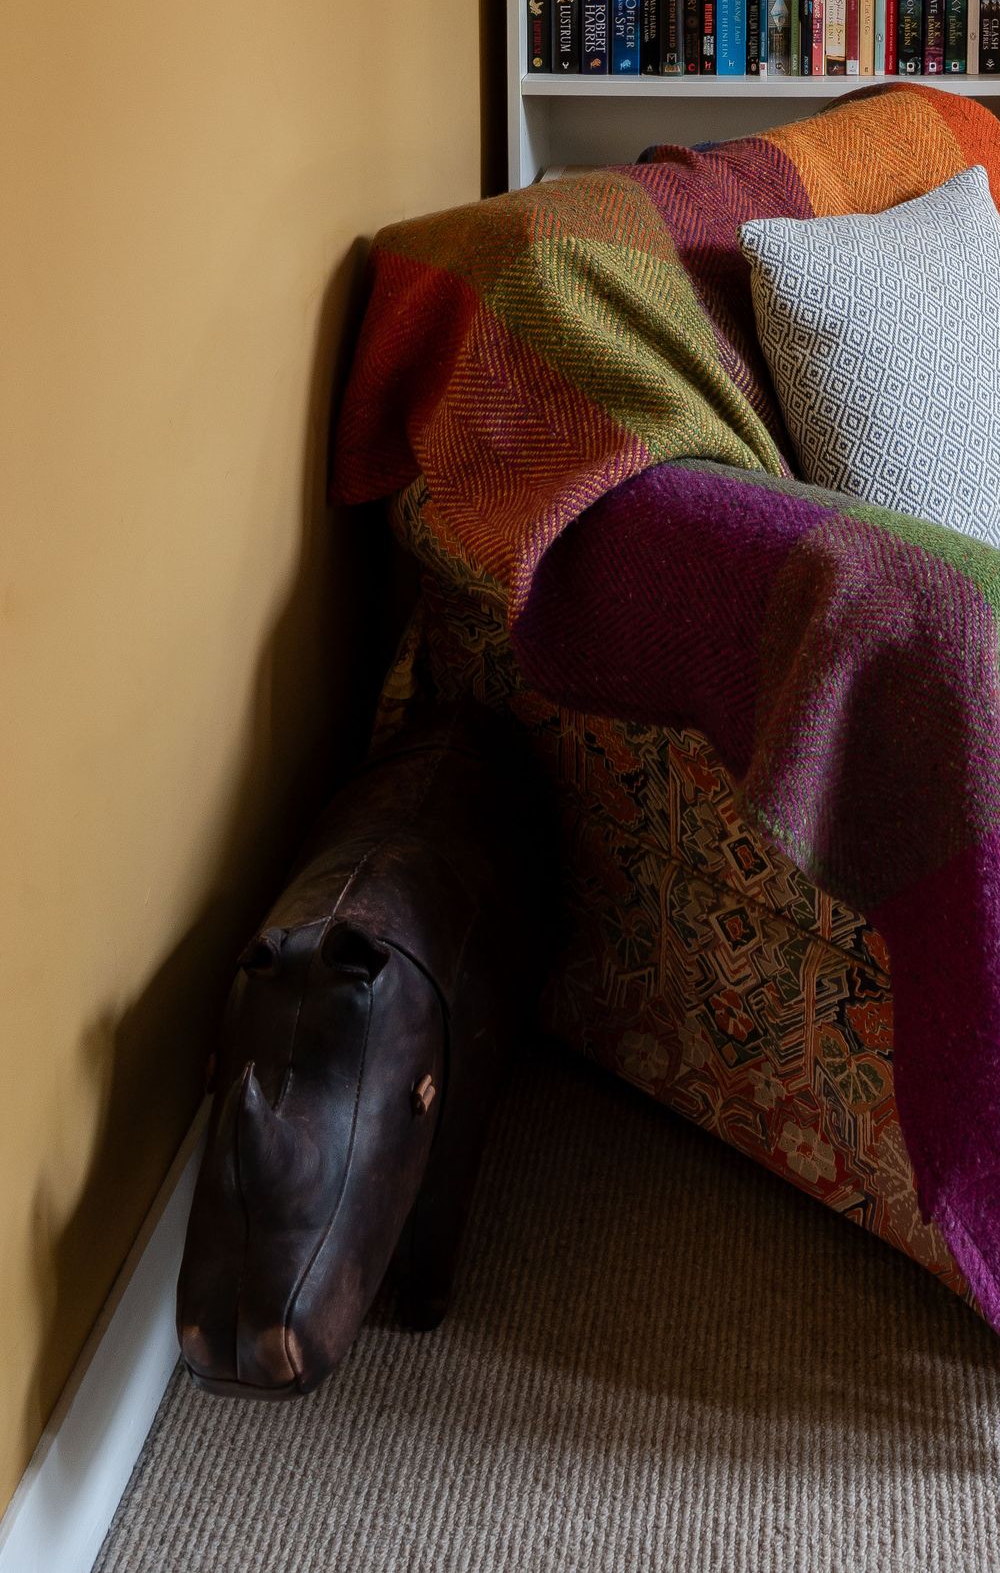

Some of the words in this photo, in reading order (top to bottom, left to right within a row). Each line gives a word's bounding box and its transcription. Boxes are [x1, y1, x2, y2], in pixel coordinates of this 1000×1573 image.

[864, 4, 872, 14] Let
[864, 16, 872, 24] Me
[560, 5, 570, 52] LUSTRUM
[584, 4, 595, 52] HARRIS
[595, 4, 606, 53] ROBERT
[615, 16, 626, 37] SPY
[668, 25, 676, 48] BLIND
[904, 16, 912, 46] JEMISIN
[982, 18, 990, 50] EMPIRES
